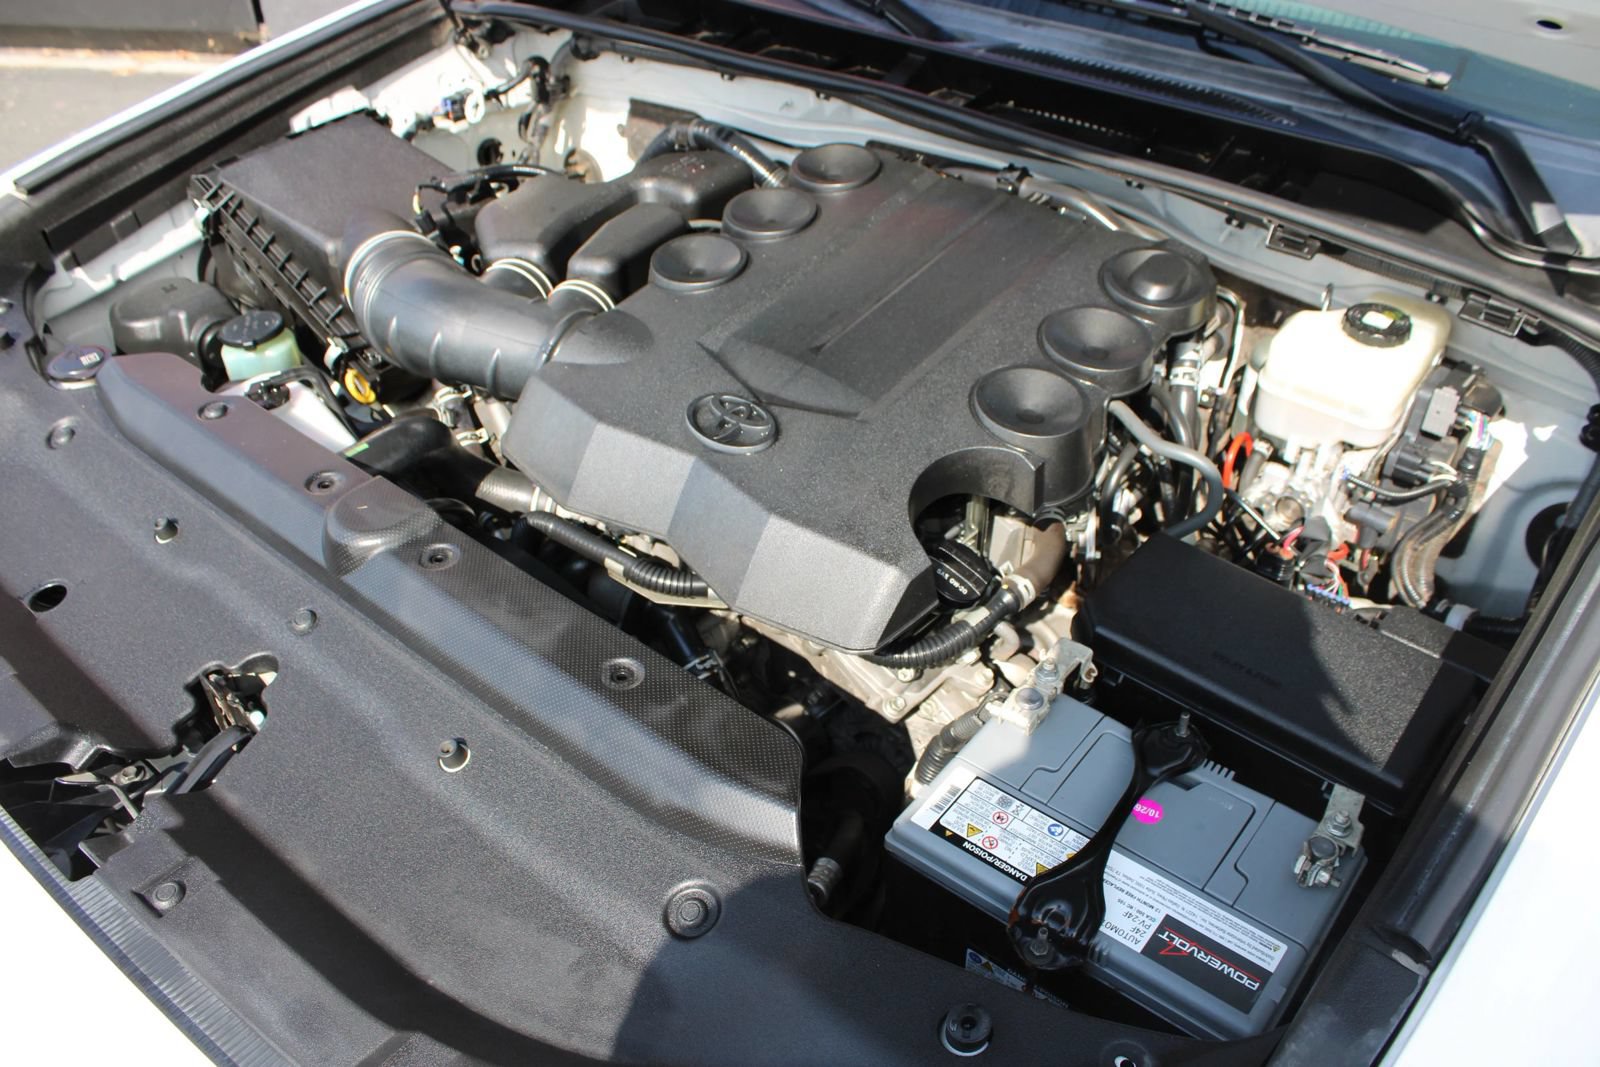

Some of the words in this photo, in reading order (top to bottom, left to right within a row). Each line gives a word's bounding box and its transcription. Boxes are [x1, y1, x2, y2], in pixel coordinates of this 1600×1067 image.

[1132, 802, 1160, 818] 10/26
[962, 840, 1027, 881] DANGER/POISON
[1121, 909, 1152, 930] PV-24F
[1129, 924, 1146, 938] 24F
[1155, 927, 1260, 990] POWERVOLT
